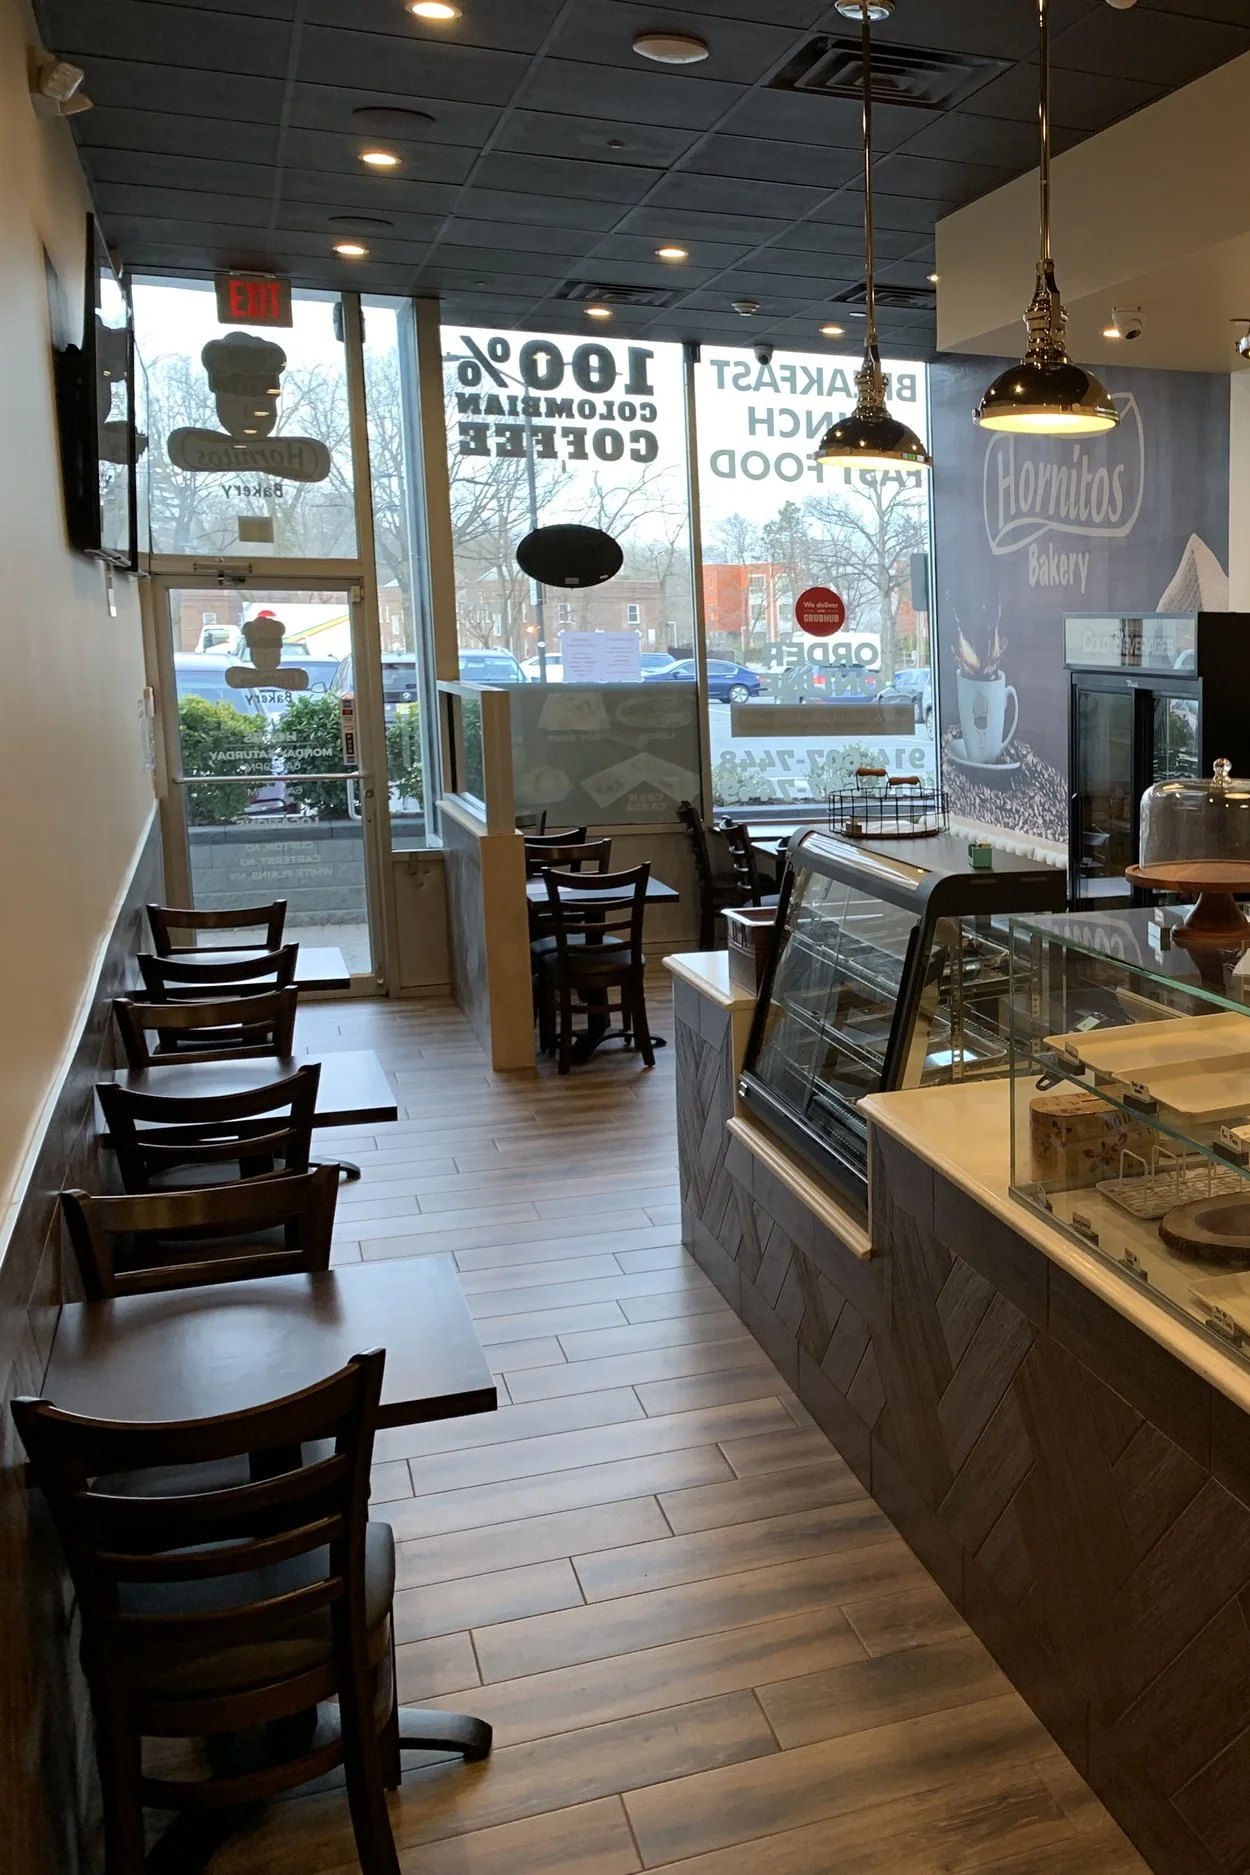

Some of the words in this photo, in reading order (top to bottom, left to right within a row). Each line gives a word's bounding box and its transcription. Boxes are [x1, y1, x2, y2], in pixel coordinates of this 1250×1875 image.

[229, 279, 280, 319] EXIT
[997, 435, 1125, 530] Hornitos
[1029, 543, 1089, 594] Bakery
[803, 601, 815, 609] We
[816, 601, 839, 609] deliver
[803, 613, 840, 623] GRUBHUB
